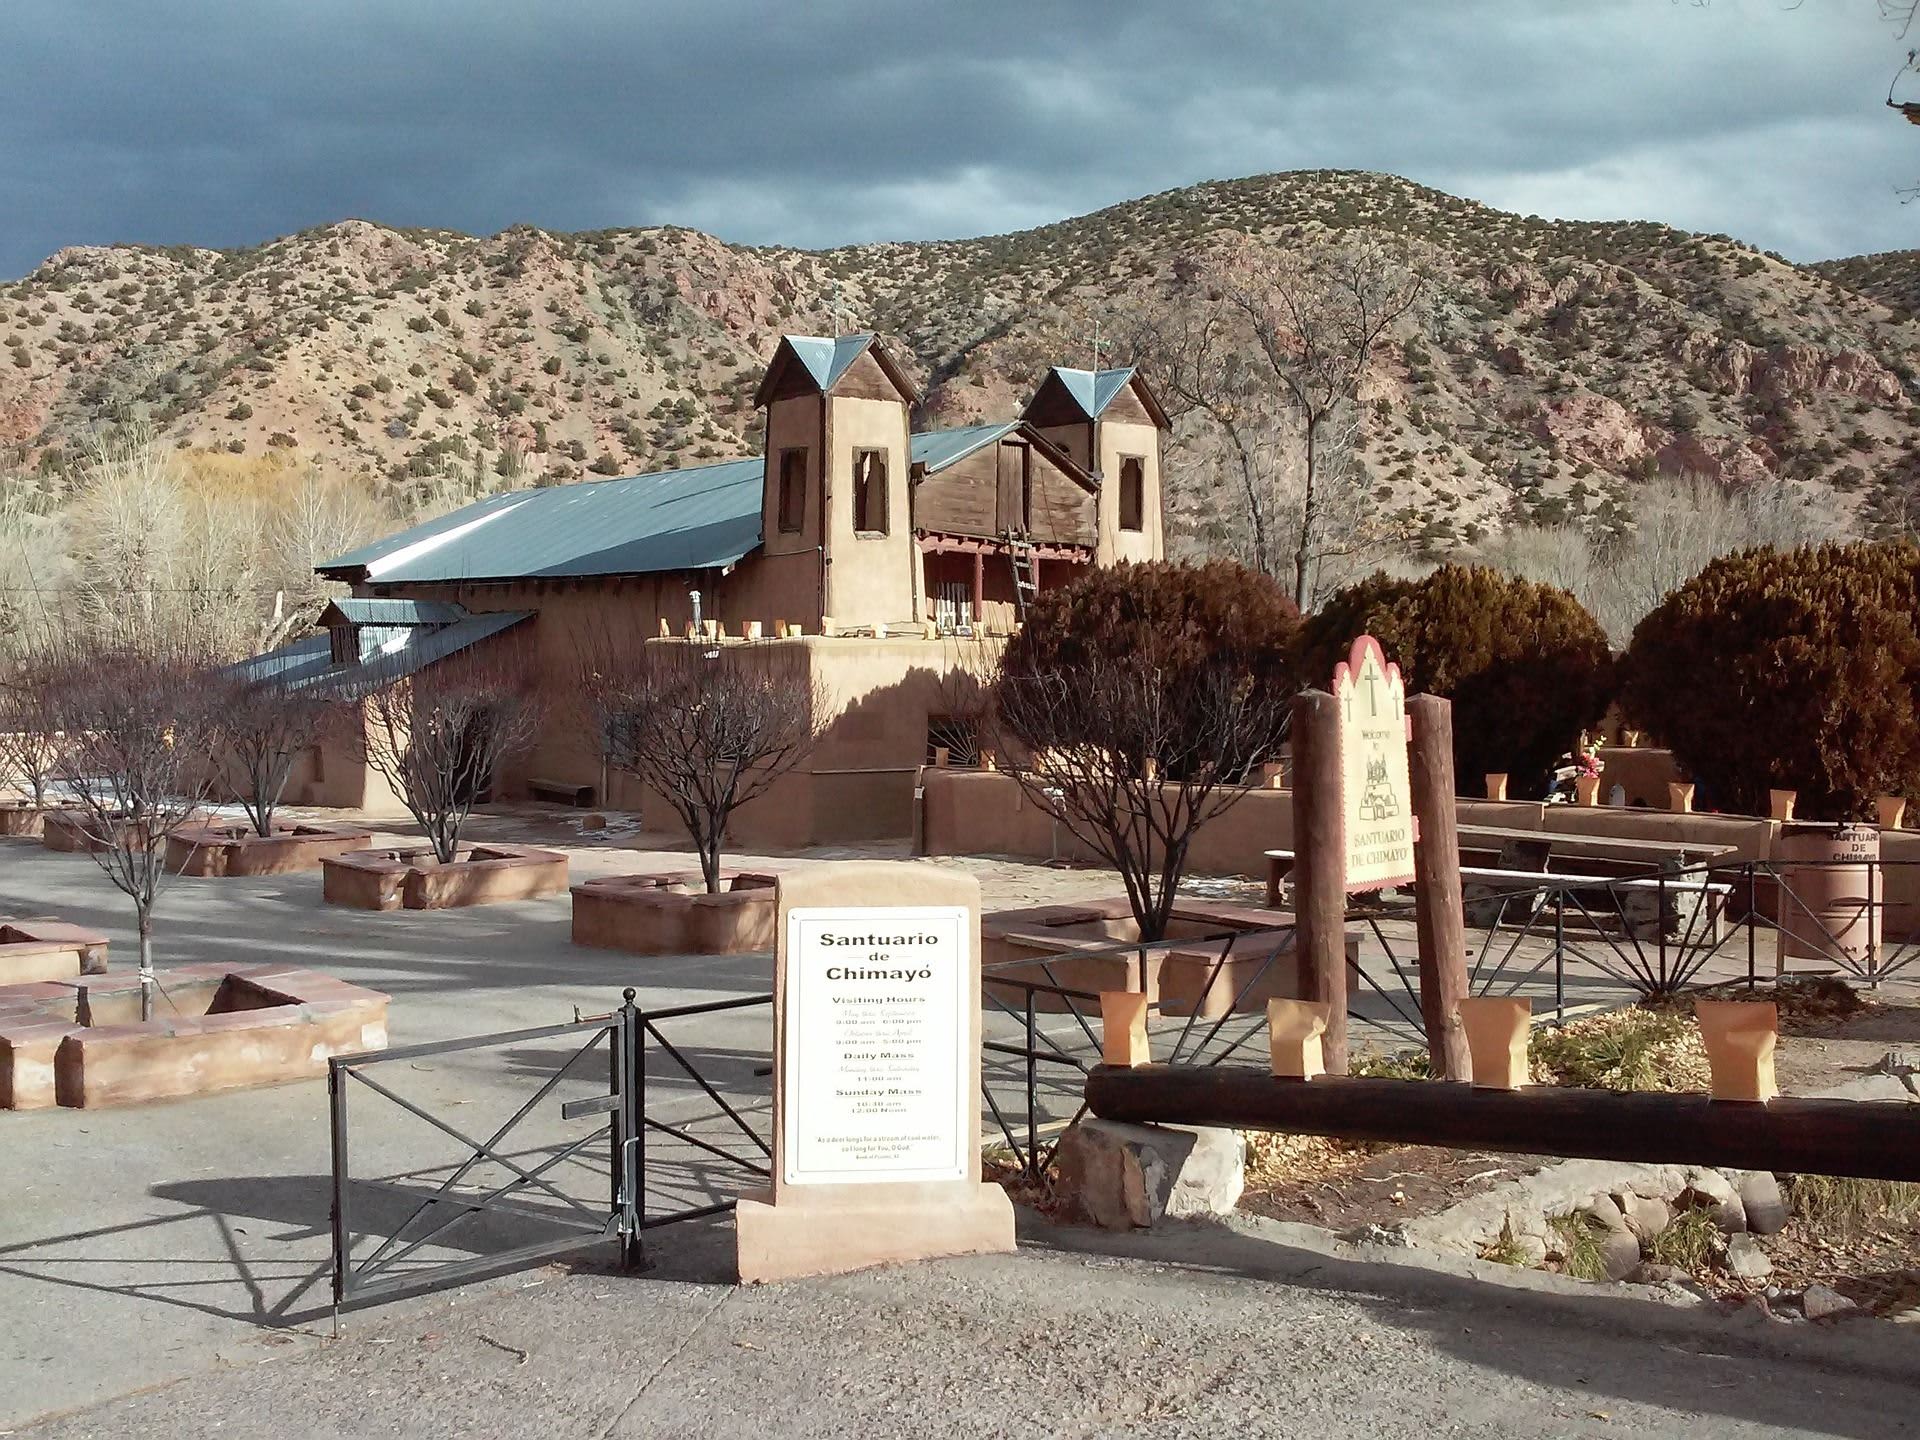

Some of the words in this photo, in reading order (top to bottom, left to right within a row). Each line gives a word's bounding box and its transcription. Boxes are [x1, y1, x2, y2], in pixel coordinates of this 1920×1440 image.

[1353, 828, 1405, 848] SANTUARIO
[1851, 844, 1866, 852] DE
[1351, 854, 1364, 867] DE
[820, 932, 938, 946] Santuario
[868, 952, 890, 961] de
[826, 963, 932, 982] Chimayó
[832, 996, 883, 1005] Visiting
[843, 1052, 877, 1061] Daily
[835, 1089, 885, 1097] Sunday
